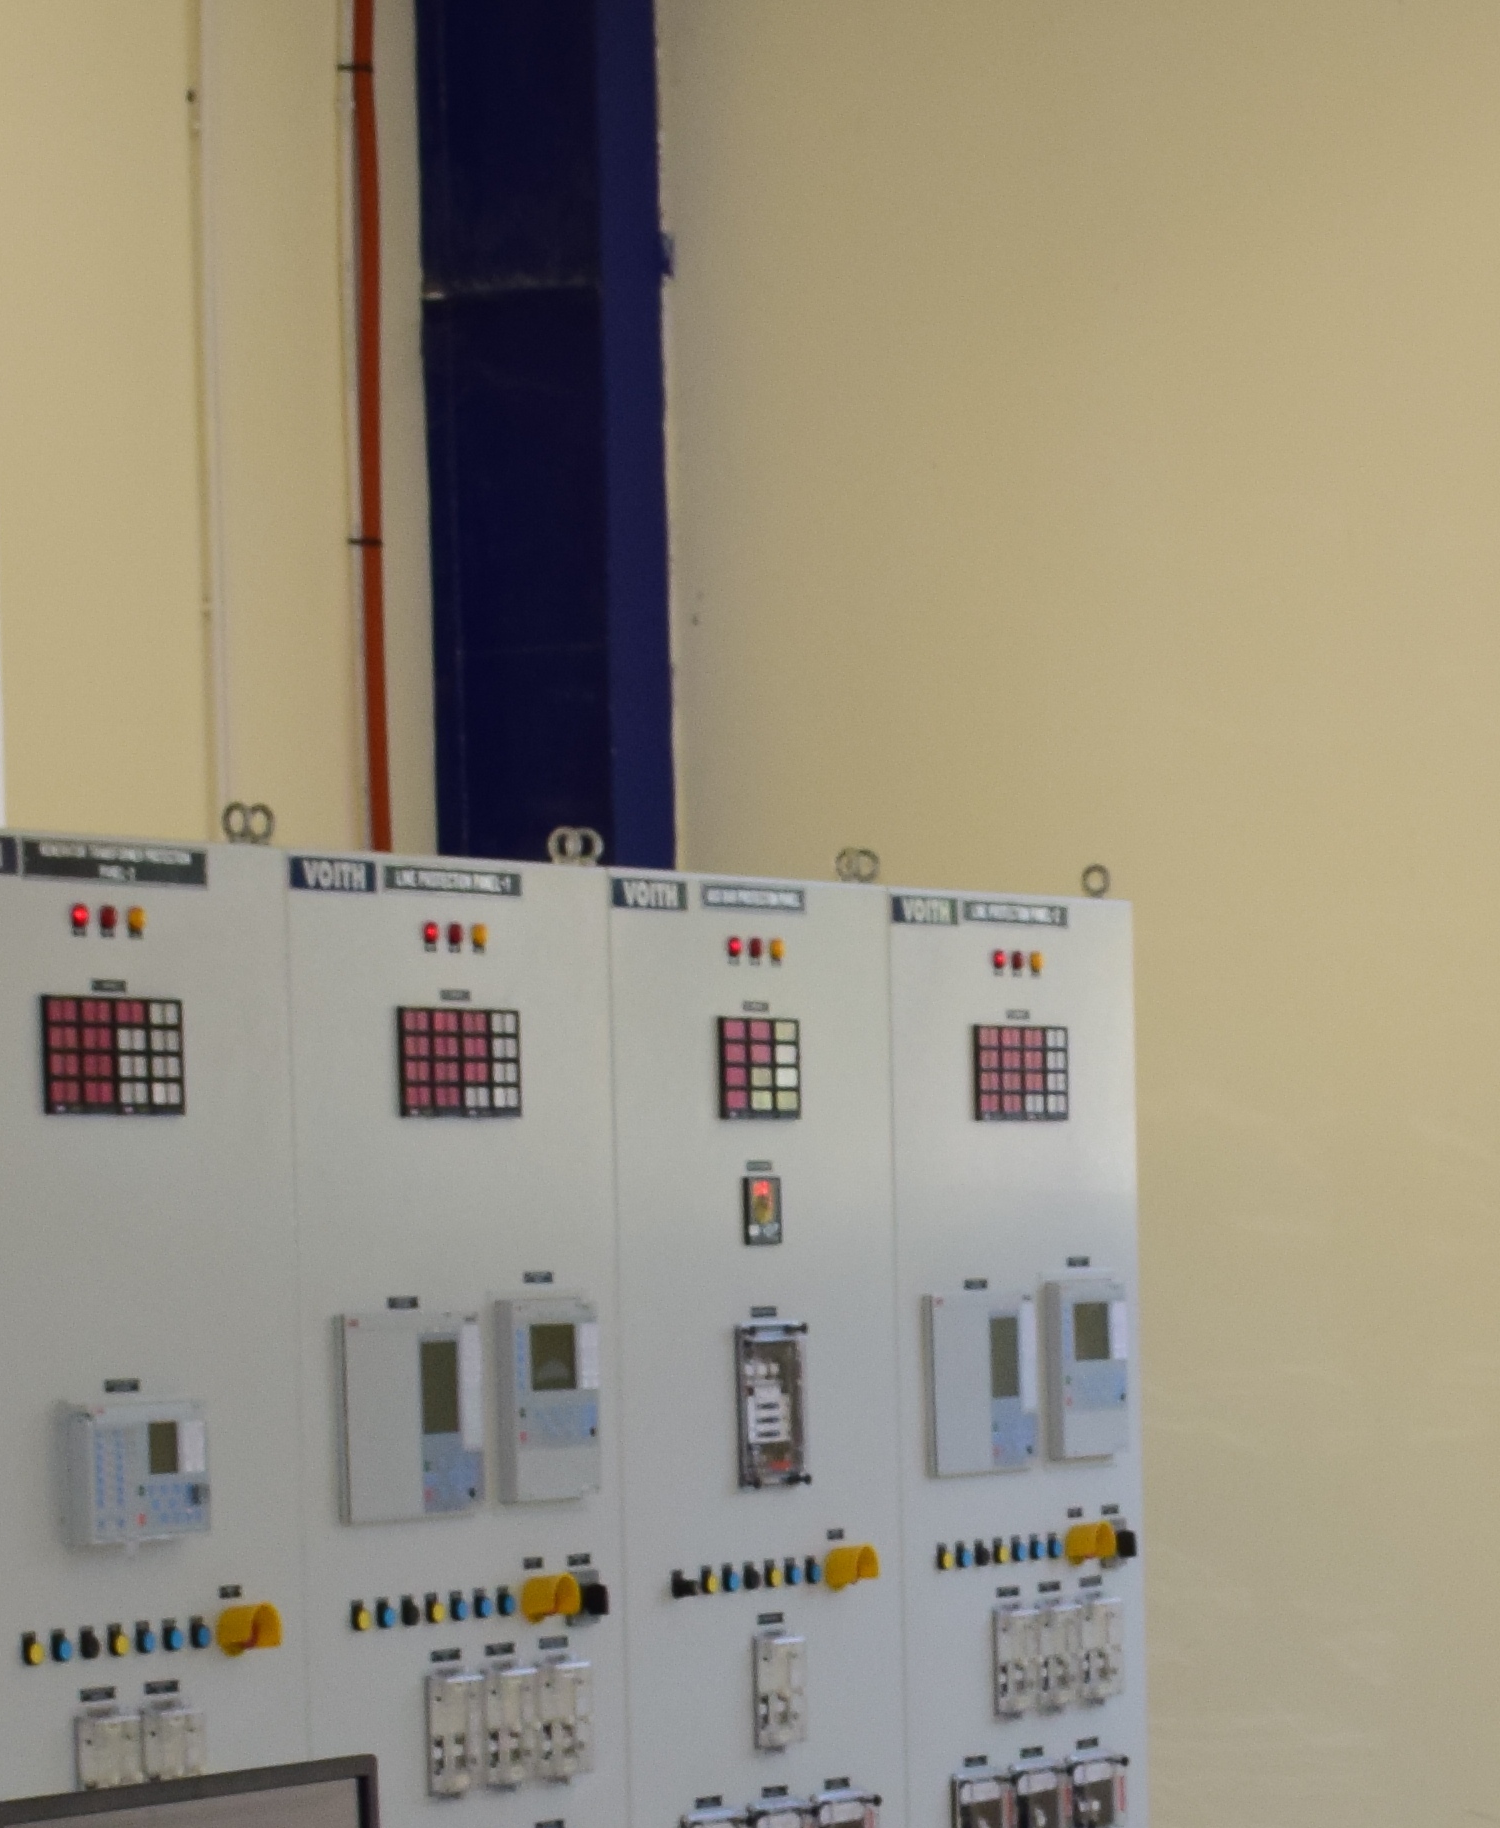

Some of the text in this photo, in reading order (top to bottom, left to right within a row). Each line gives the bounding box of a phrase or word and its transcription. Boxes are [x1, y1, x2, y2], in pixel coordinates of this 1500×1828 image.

[303, 860, 366, 891] VOITH
[624, 880, 678, 907] VOITH
[904, 899, 950, 923] VOITH
